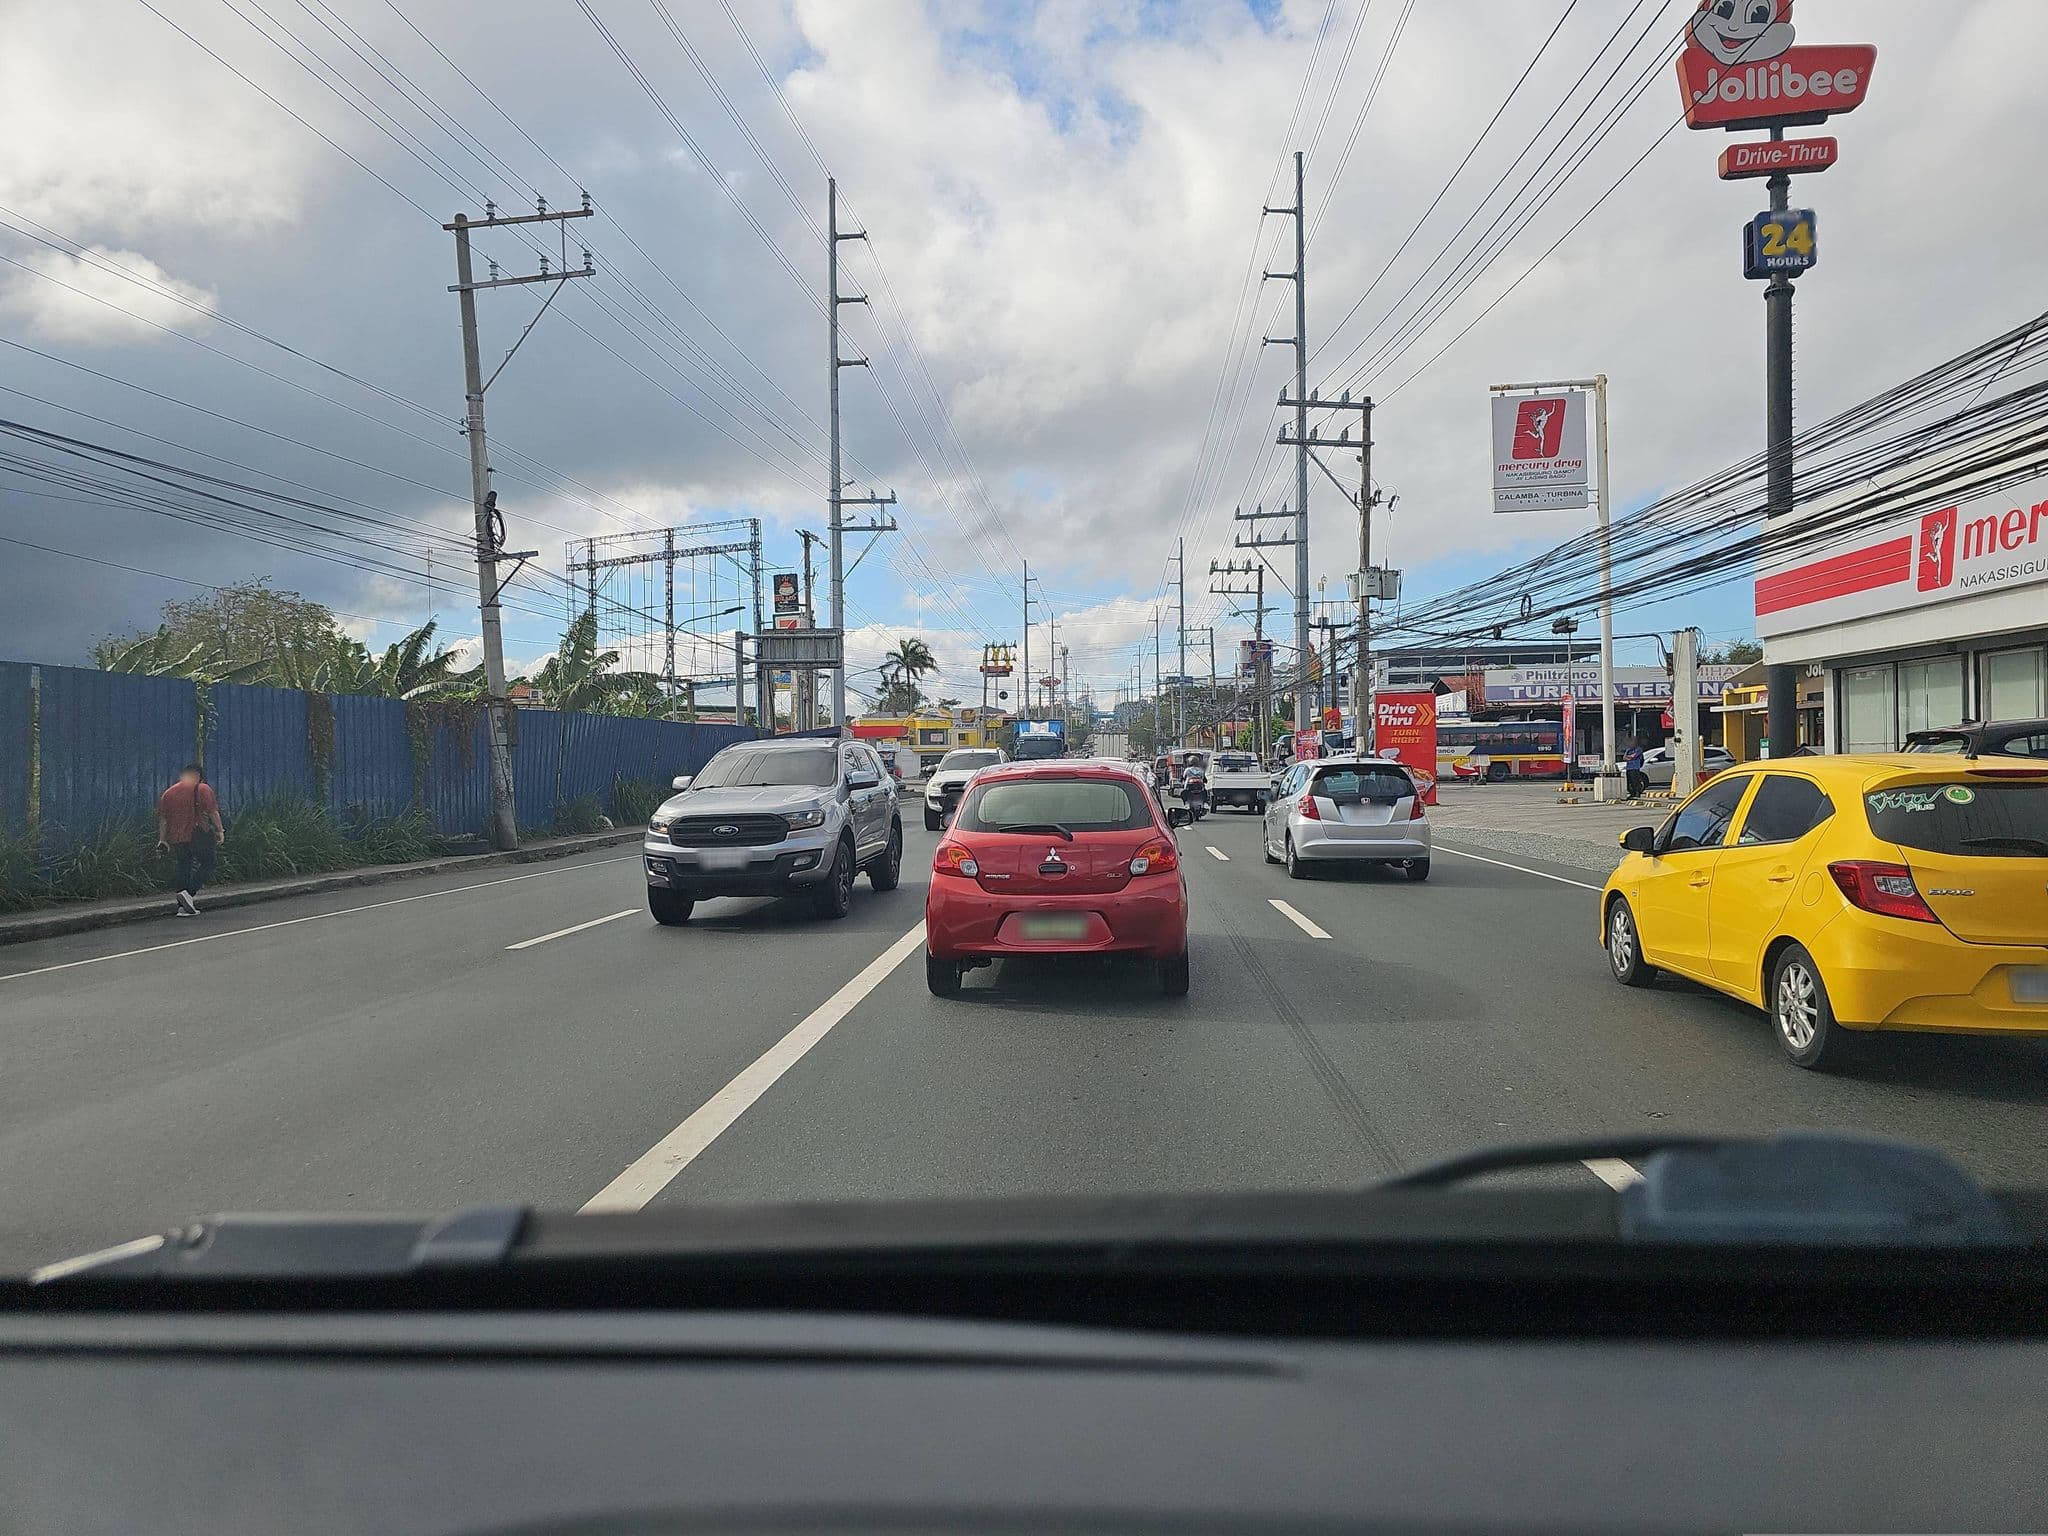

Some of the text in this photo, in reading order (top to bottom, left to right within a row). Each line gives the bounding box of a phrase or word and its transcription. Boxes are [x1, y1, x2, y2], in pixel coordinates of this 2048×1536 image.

[1693, 61, 1857, 104] Jollibee
[1736, 143, 1829, 167] Drive-Thru
[1761, 221, 1813, 256] 24
[1767, 256, 1809, 267] HOURS
[1498, 459, 1582, 472] mercury drug
[1498, 492, 1540, 501] CALAMBA
[1546, 490, 1583, 499] TURBINA
[1960, 558, 2048, 589] NAKASISIGU
[1526, 670, 1597, 681] Philtranco
[1378, 703, 1416, 715] Drive
[1379, 715, 1413, 726] Thru
